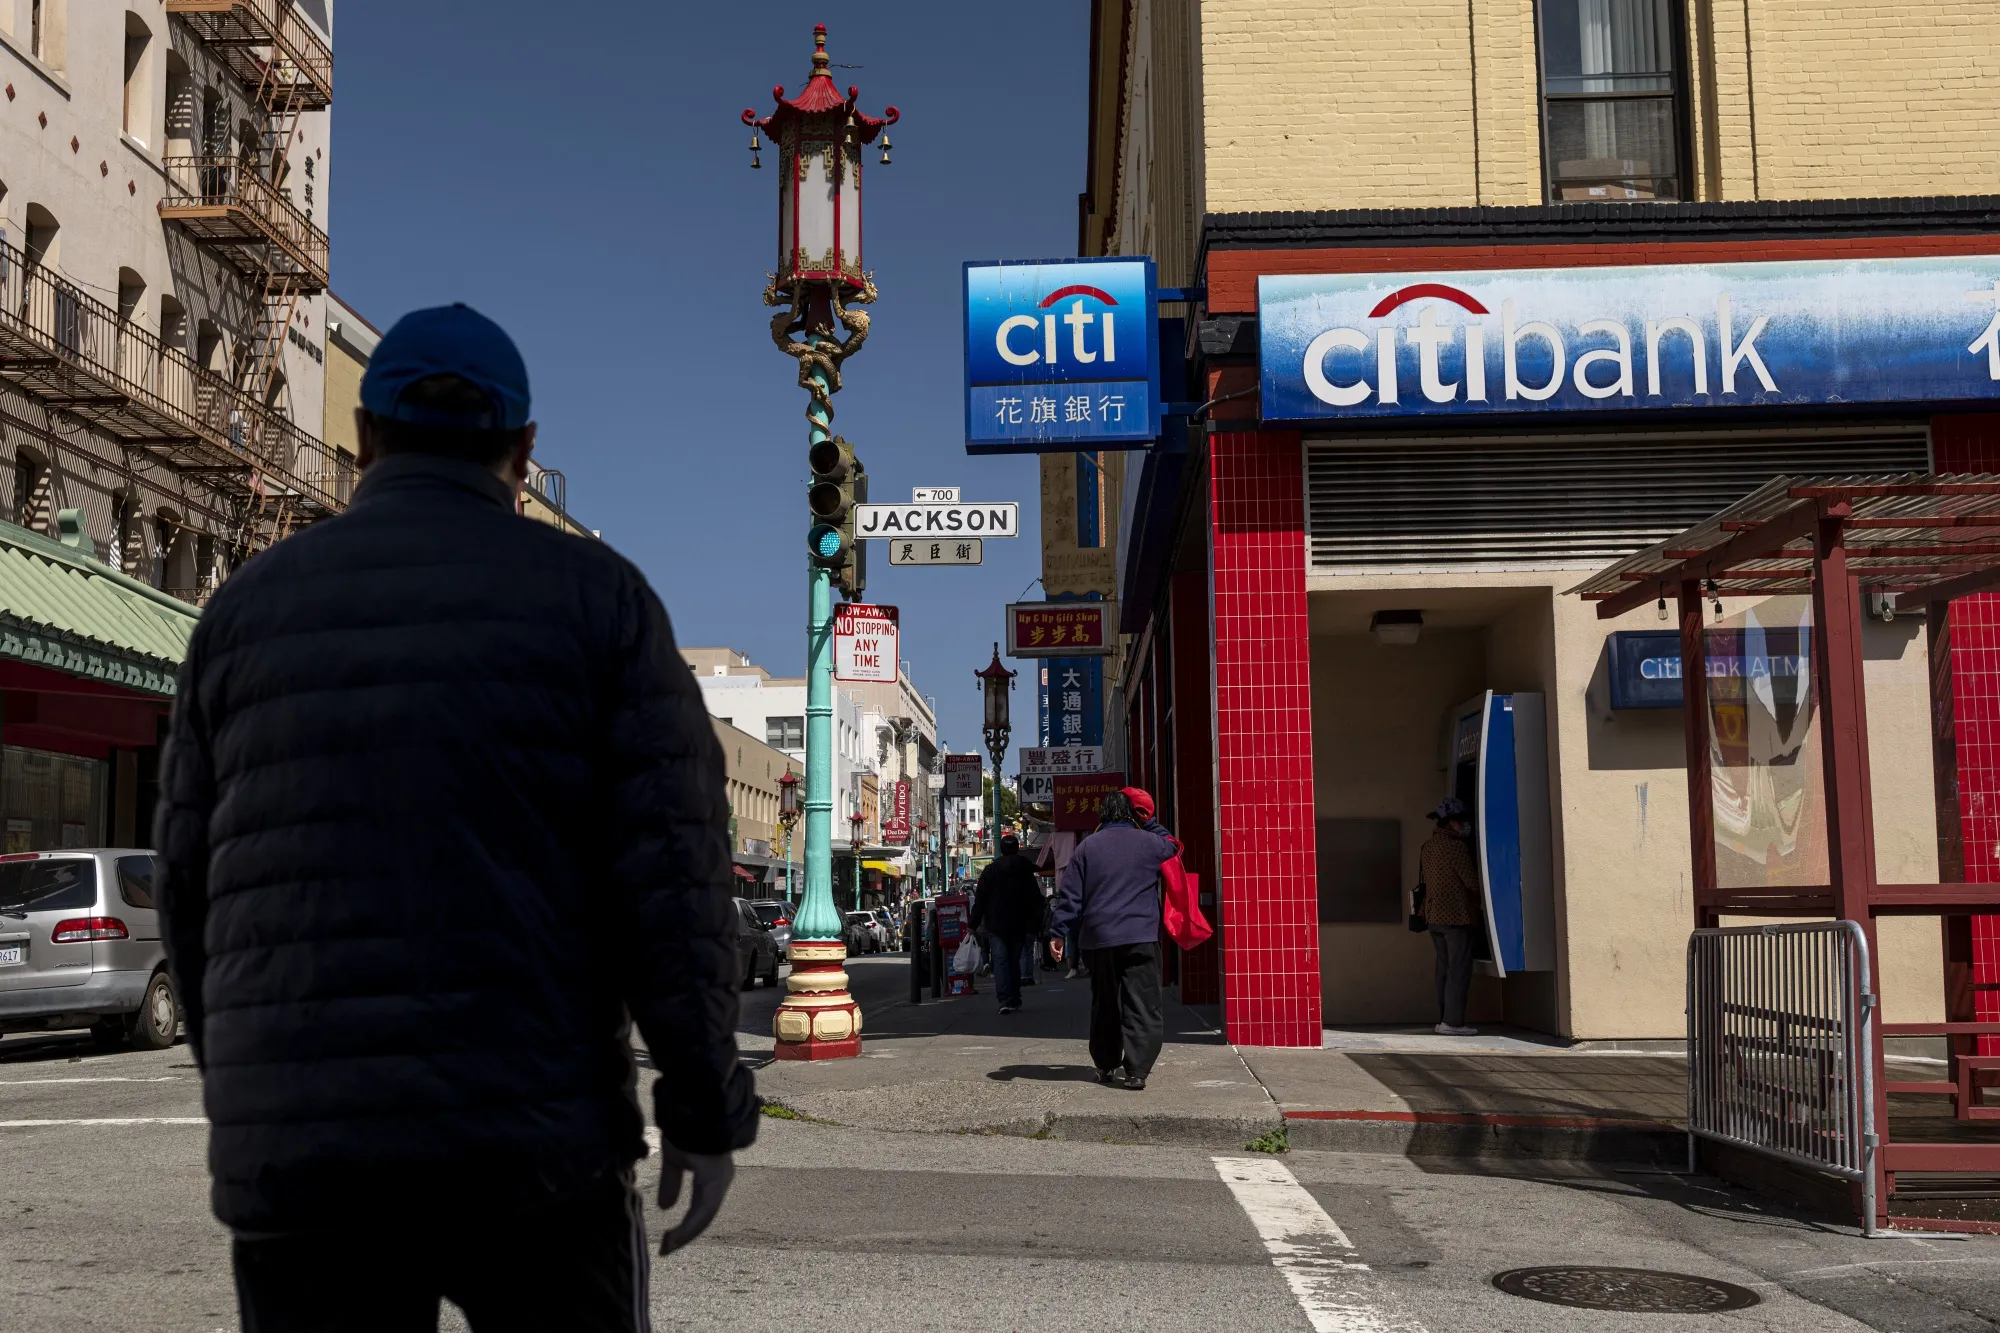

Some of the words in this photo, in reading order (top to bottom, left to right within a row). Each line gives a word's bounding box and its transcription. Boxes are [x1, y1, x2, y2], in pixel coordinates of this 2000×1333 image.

[995, 295, 1116, 367] citi
[1303, 294, 1781, 407] citibank
[994, 395, 1126, 427] 花旗銀行
[930, 490, 953, 500] 700
[862, 510, 1007, 532] JACKSON
[840, 606, 893, 618] TOW-AWAY
[1018, 613, 1031, 624] Up
[1032, 613, 1040, 623] &
[1041, 613, 1054, 624] Up
[1056, 613, 1073, 623] Gift
[1075, 612, 1099, 622] Shop
[836, 617, 853, 635] NO
[856, 622, 895, 636] STOPPING
[855, 639, 878, 652] ANY
[853, 655, 880, 668] TIME
[1639, 657, 1740, 679] Citiank
[1028, 750, 1095, 766] 豐盛行
[957, 773, 970, 781] ANY
[898, 785, 906, 828] SHISEIDO
